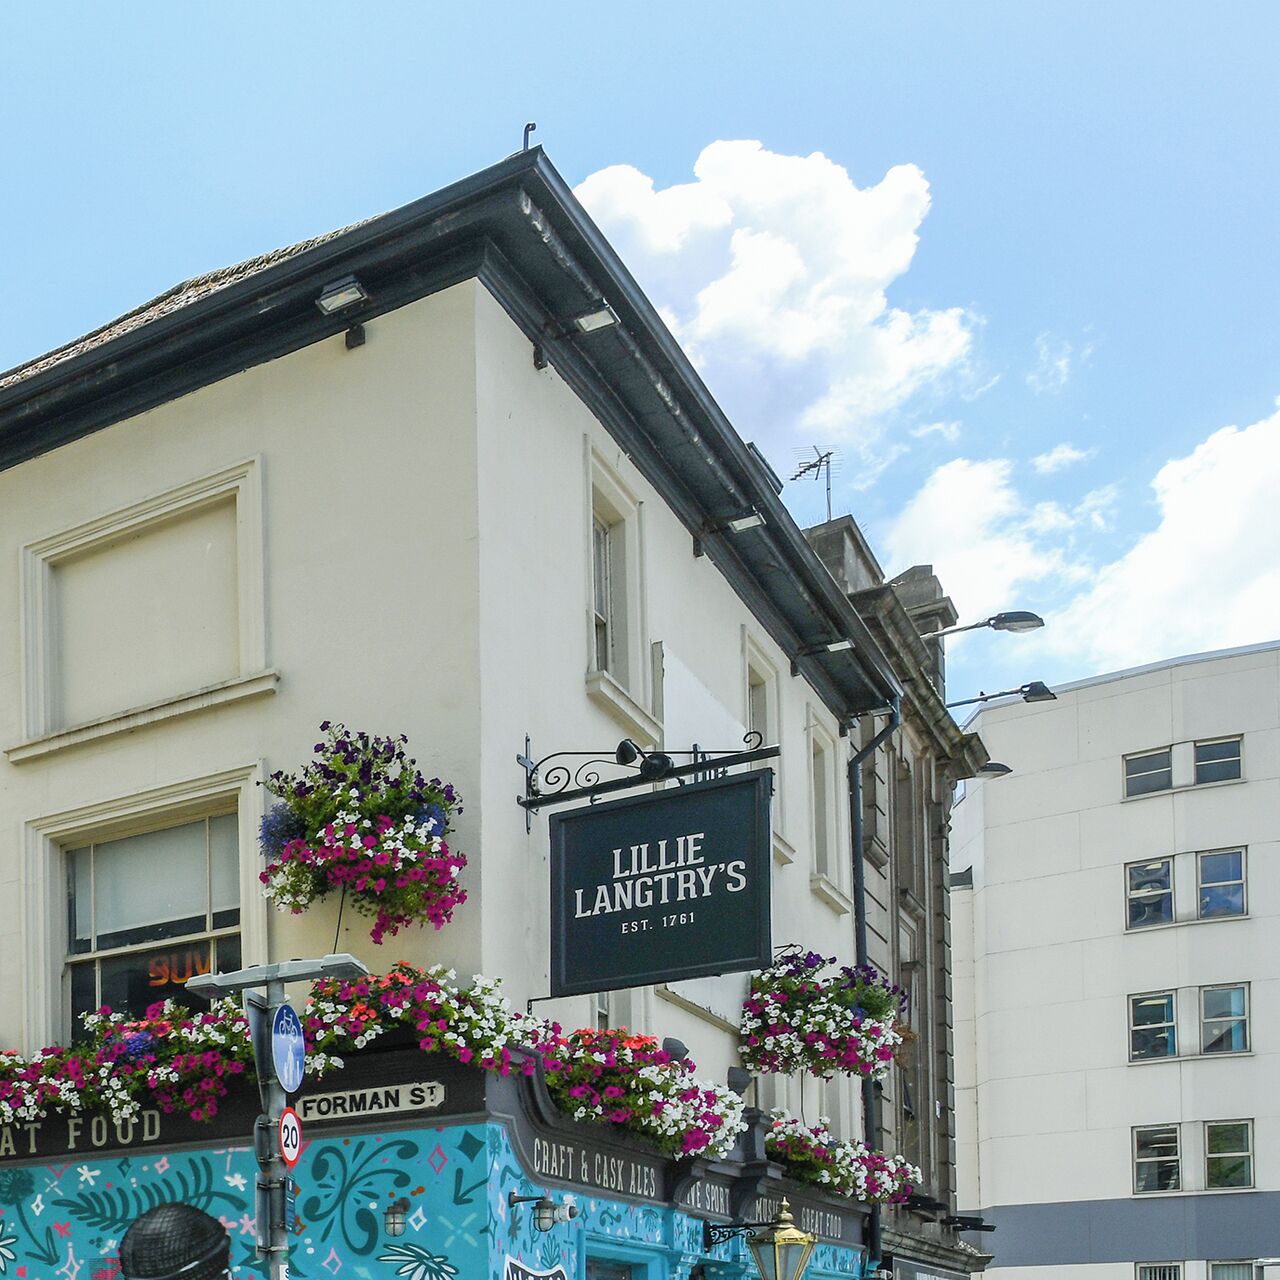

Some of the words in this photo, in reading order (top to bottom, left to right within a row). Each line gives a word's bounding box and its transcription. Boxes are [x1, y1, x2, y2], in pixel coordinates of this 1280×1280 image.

[612, 832, 705, 879] LILLIE
[574, 860, 747, 919] LANGTRY'S
[621, 919, 653, 935] EST.
[662, 911, 696, 928] 1761
[302, 1089, 400, 1118] FORMAN
[67, 1109, 161, 1150] FOOD
[282, 1124, 298, 1149] 20
[533, 1138, 574, 1181] CRAFT
[581, 1151, 589, 1182] &
[593, 1153, 625, 1192] CASK
[629, 1164, 656, 1198] ALES
[705, 1183, 730, 1215] SPORT
[801, 1207, 823, 1234] GREAT
[826, 1213, 842, 1238] FOOD
